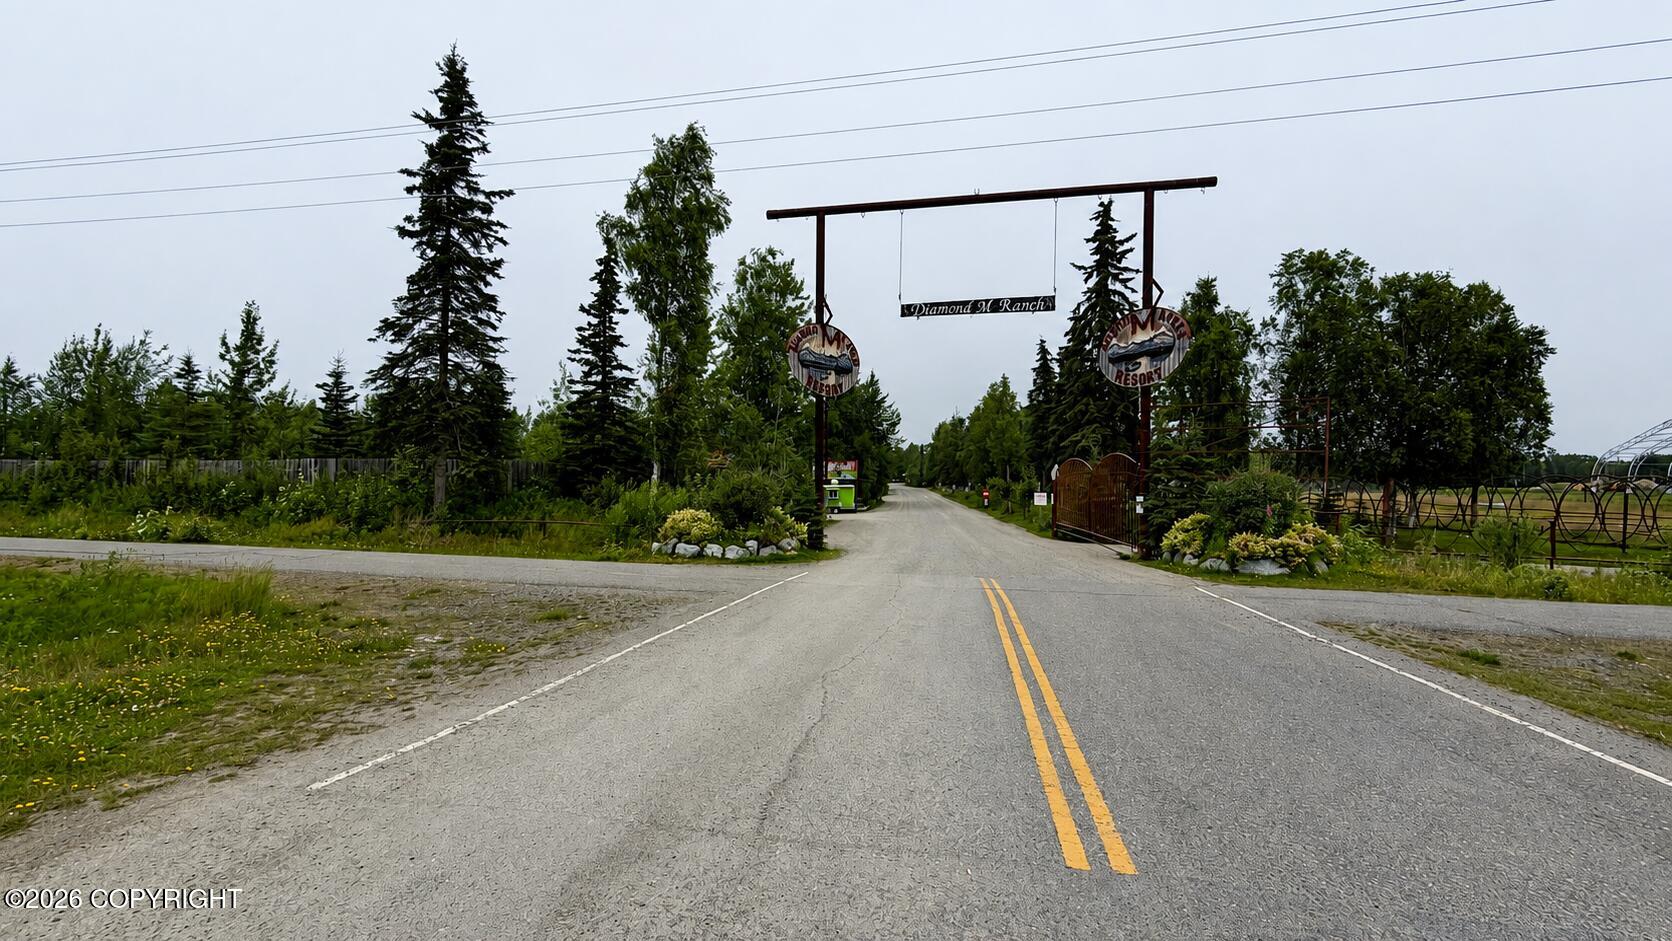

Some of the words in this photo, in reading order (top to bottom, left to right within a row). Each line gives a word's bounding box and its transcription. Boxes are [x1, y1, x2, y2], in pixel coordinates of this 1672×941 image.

[911, 300, 973, 316] Diamond
[976, 299, 994, 313] M
[1000, 296, 1044, 312] Ranch
[1130, 308, 1157, 335] M
[1115, 367, 1162, 387] RESORT
